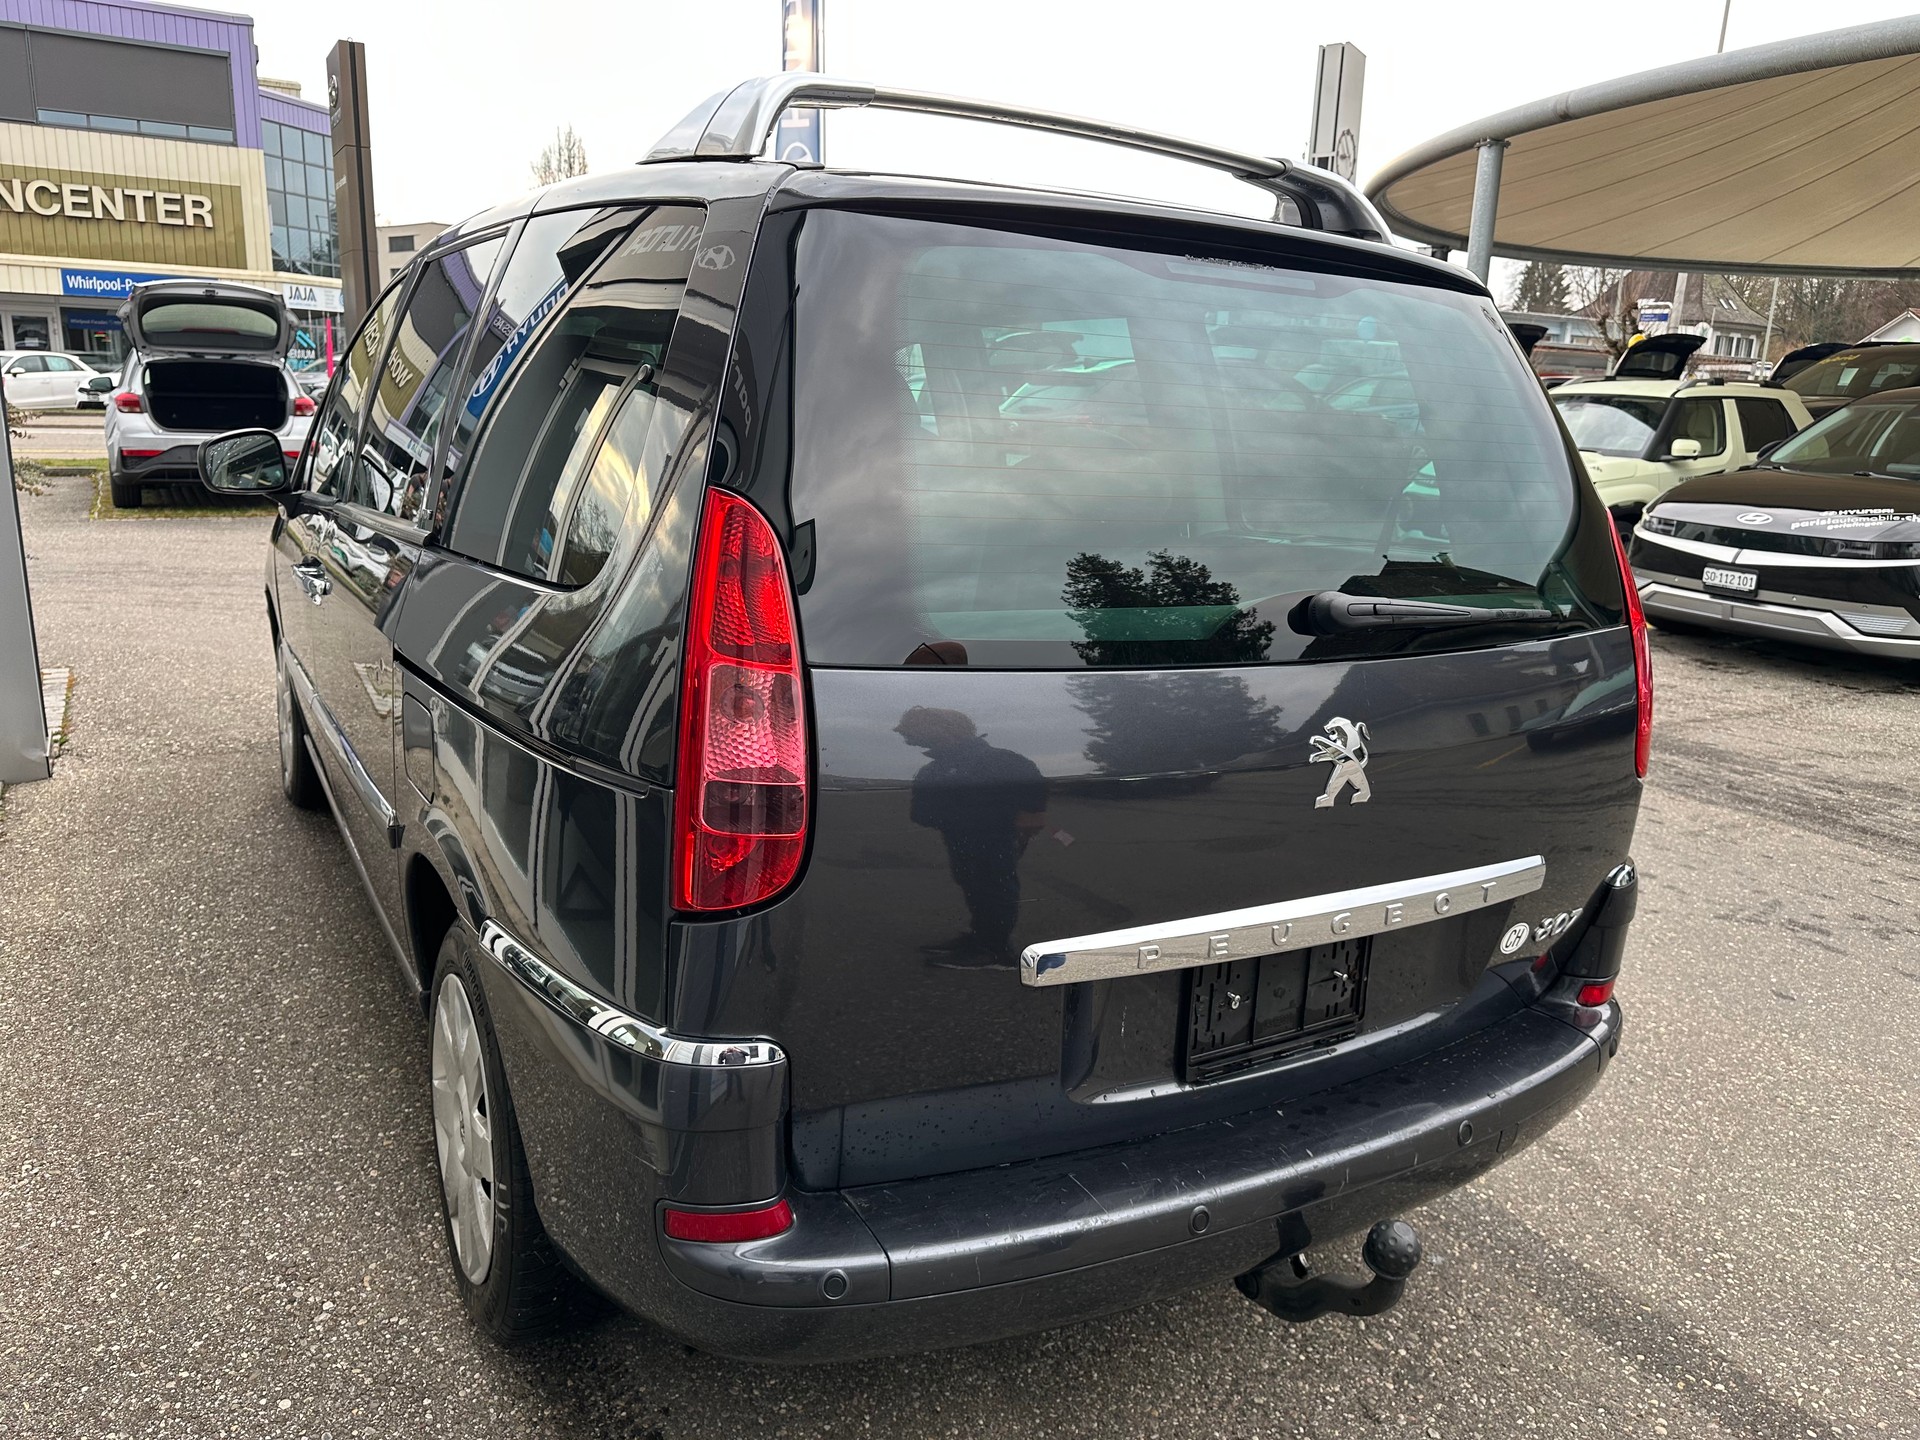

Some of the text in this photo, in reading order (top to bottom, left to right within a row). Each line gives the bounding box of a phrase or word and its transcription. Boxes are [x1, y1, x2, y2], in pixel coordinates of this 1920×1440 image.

[289, 285, 317, 302] JAJA
[1137, 881, 1497, 969] PEUGEOT
[1505, 928, 1525, 948] CH
